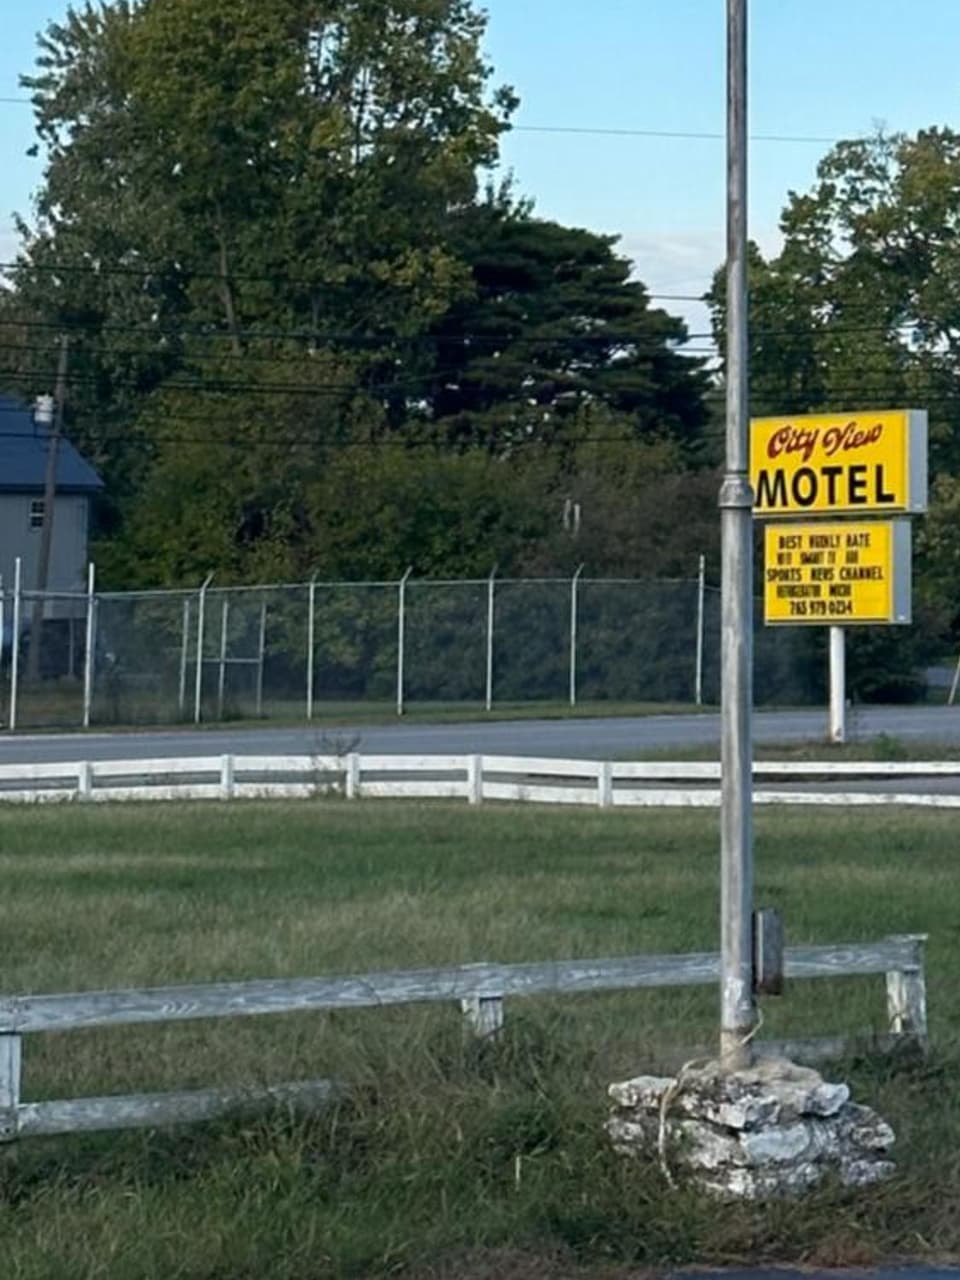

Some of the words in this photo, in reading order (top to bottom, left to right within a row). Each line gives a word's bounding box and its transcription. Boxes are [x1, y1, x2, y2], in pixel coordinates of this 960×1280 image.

[767, 424, 820, 462] City
[823, 421, 883, 456] View
[755, 464, 895, 508] MOTEL
[779, 535, 802, 549] BEST
[767, 567, 802, 582] SPORTS
[810, 567, 834, 581] NEWS
[839, 566, 884, 580] CHANNEL
